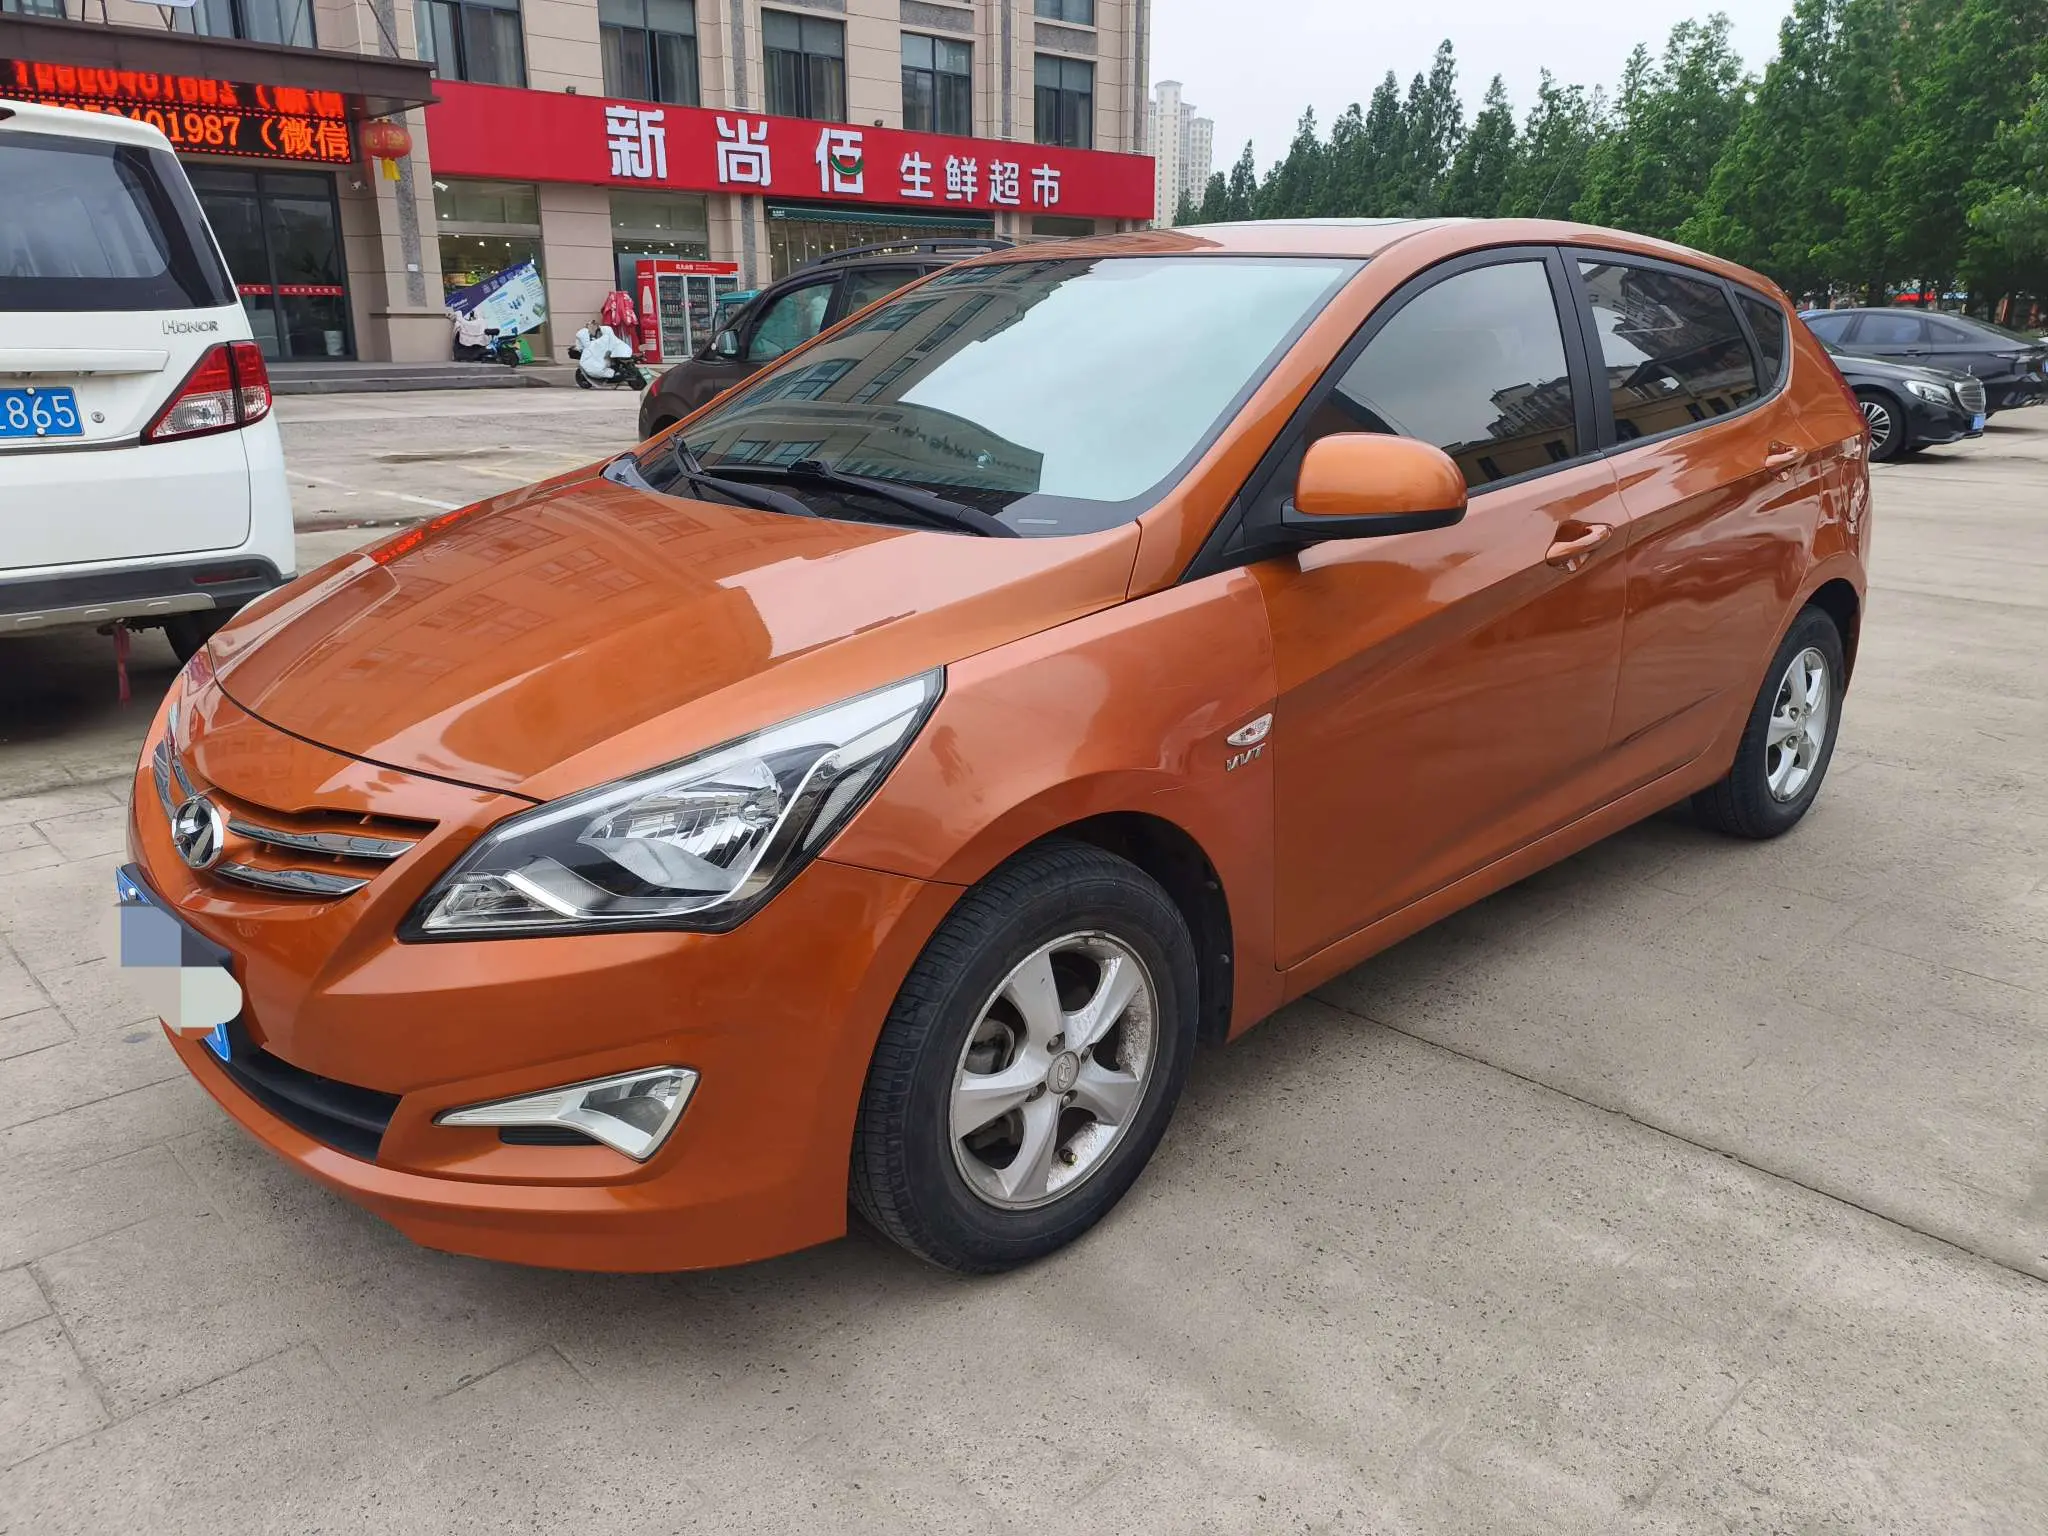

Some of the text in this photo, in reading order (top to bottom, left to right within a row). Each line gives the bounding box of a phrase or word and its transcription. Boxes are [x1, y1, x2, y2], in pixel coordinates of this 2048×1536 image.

[605, 105, 1061, 208] 新尚佰 生鲜超市
[161, 320, 219, 335] HONOR
